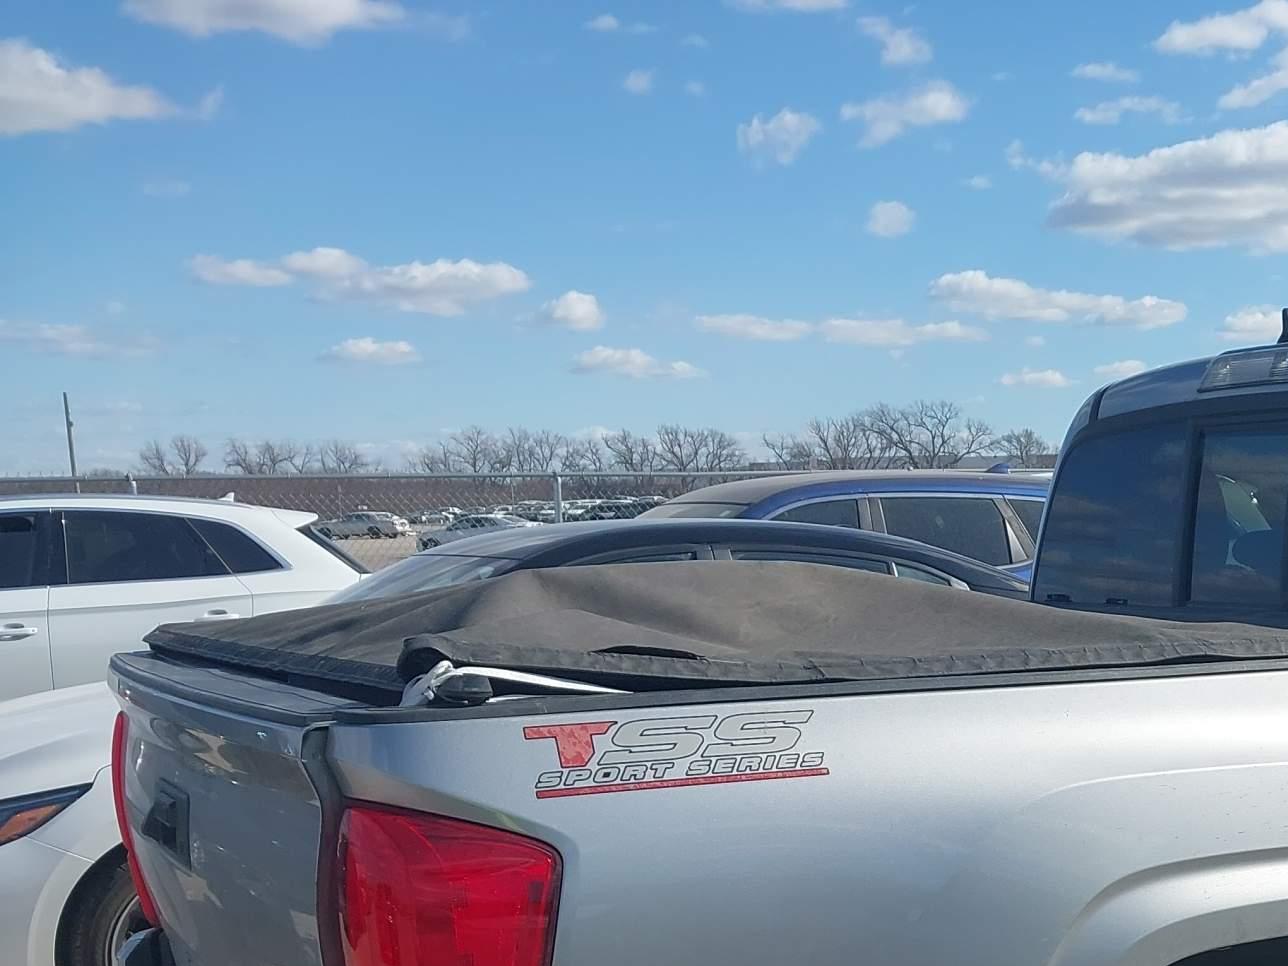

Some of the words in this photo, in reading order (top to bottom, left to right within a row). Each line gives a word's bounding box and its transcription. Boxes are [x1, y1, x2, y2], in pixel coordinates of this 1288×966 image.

[523, 710, 814, 768] TSS
[535, 762, 674, 789] SPORT
[686, 752, 825, 776] SERIES
